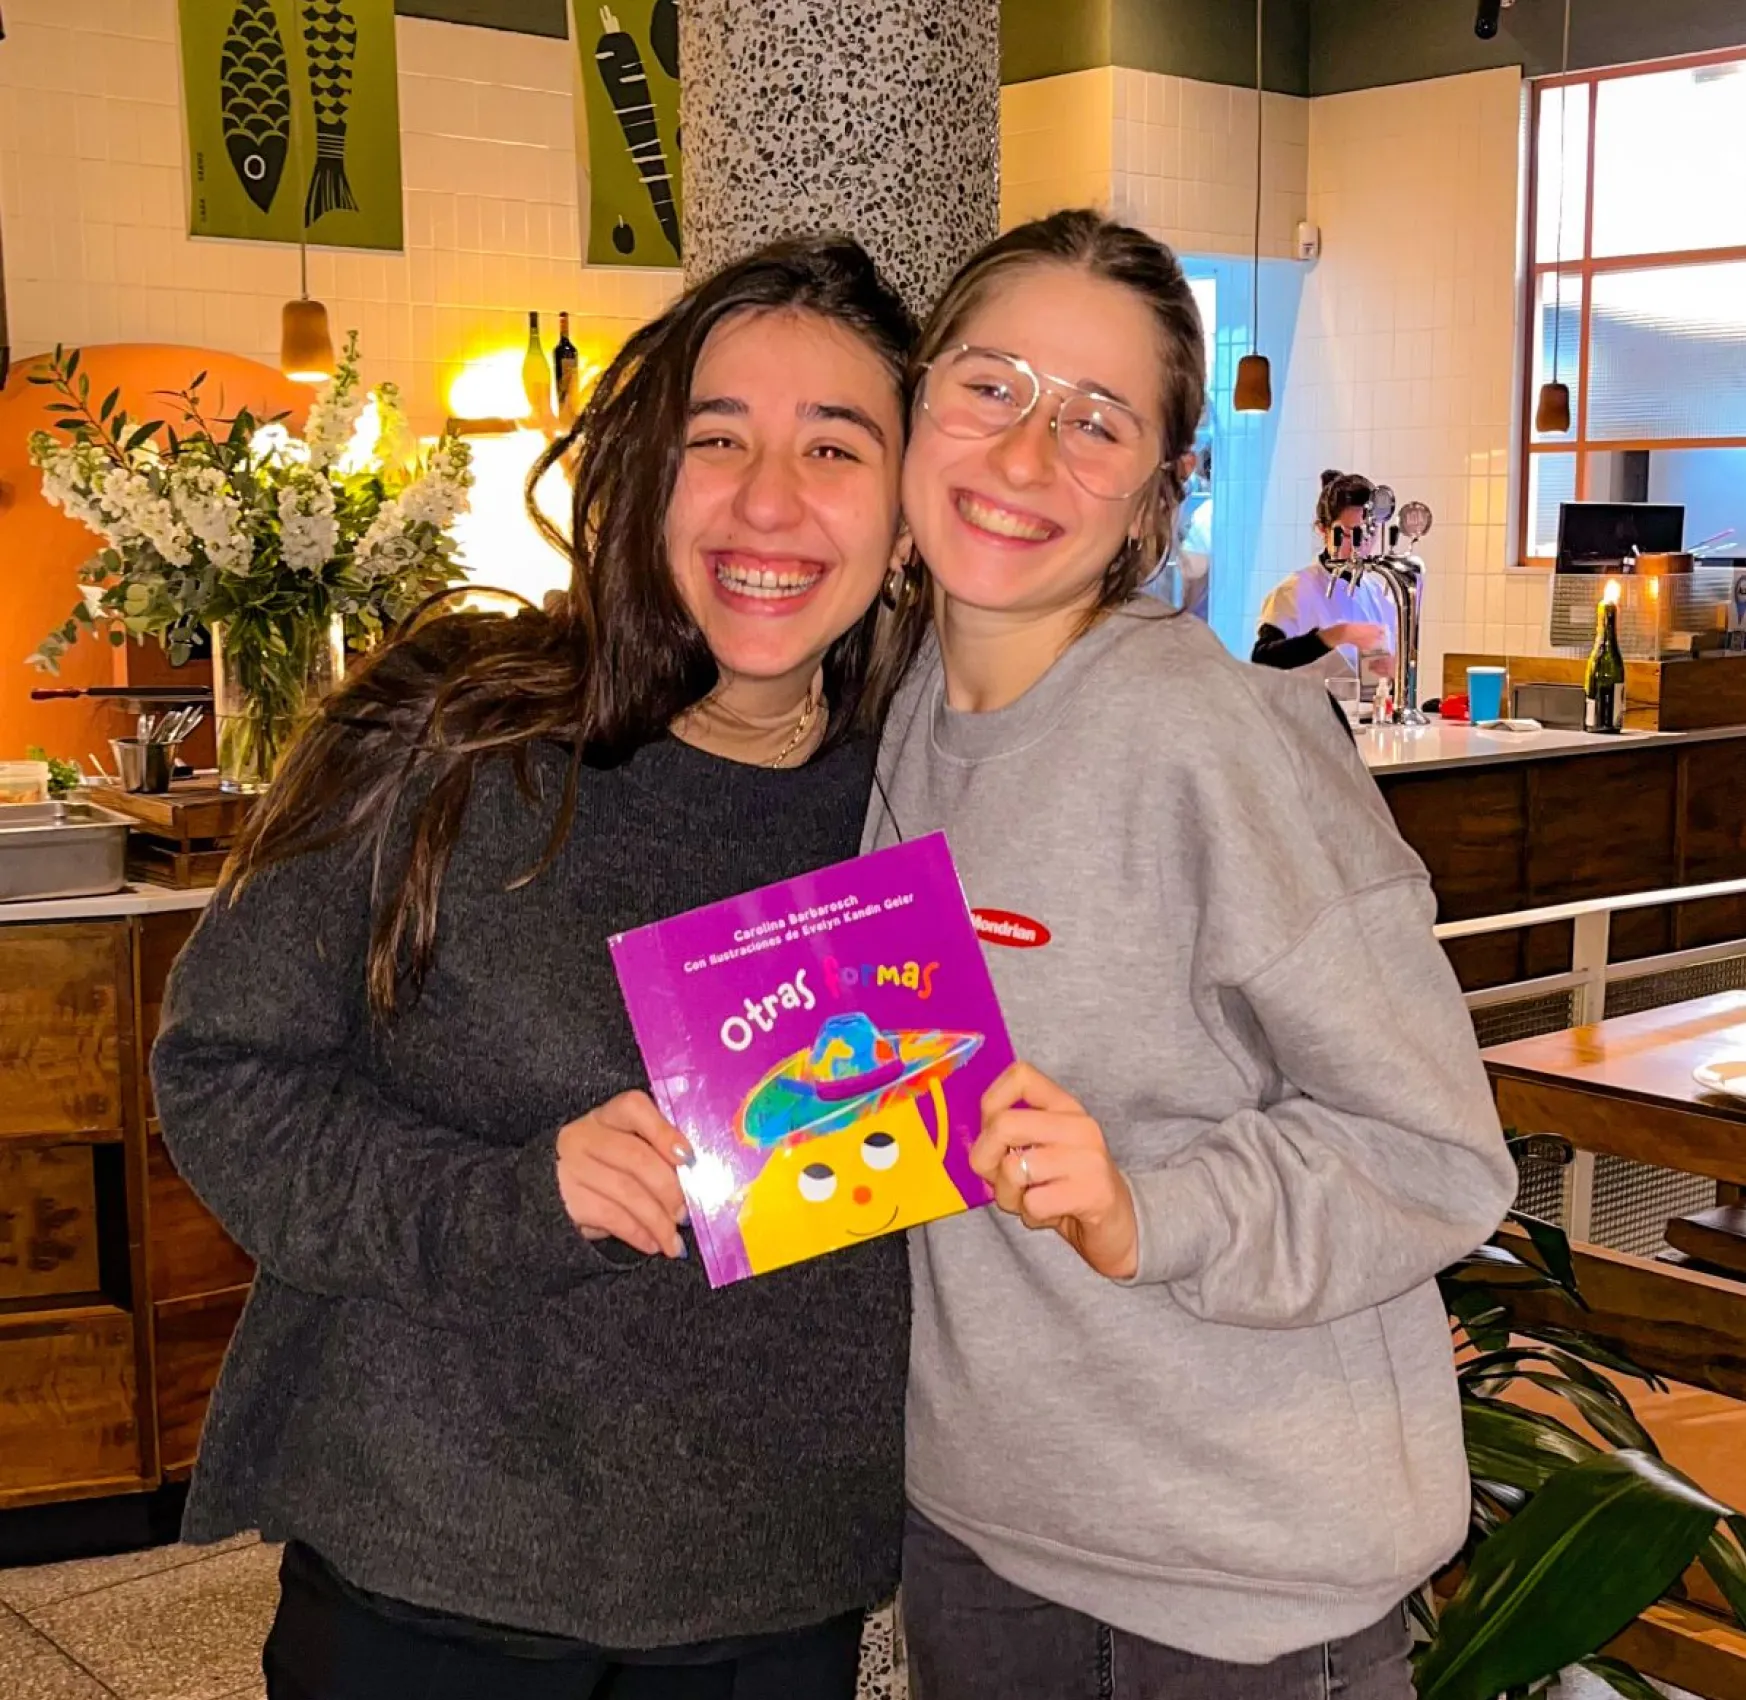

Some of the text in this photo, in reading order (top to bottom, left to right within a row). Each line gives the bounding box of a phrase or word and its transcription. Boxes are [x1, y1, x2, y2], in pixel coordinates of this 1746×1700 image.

[683, 959, 707, 973] Con
[785, 929, 799, 941] de
[802, 917, 841, 936] Evelyn
[843, 904, 882, 923] Kandin
[734, 895, 859, 942] Carolina Barbarosch
[720, 968, 817, 1052] Otras
